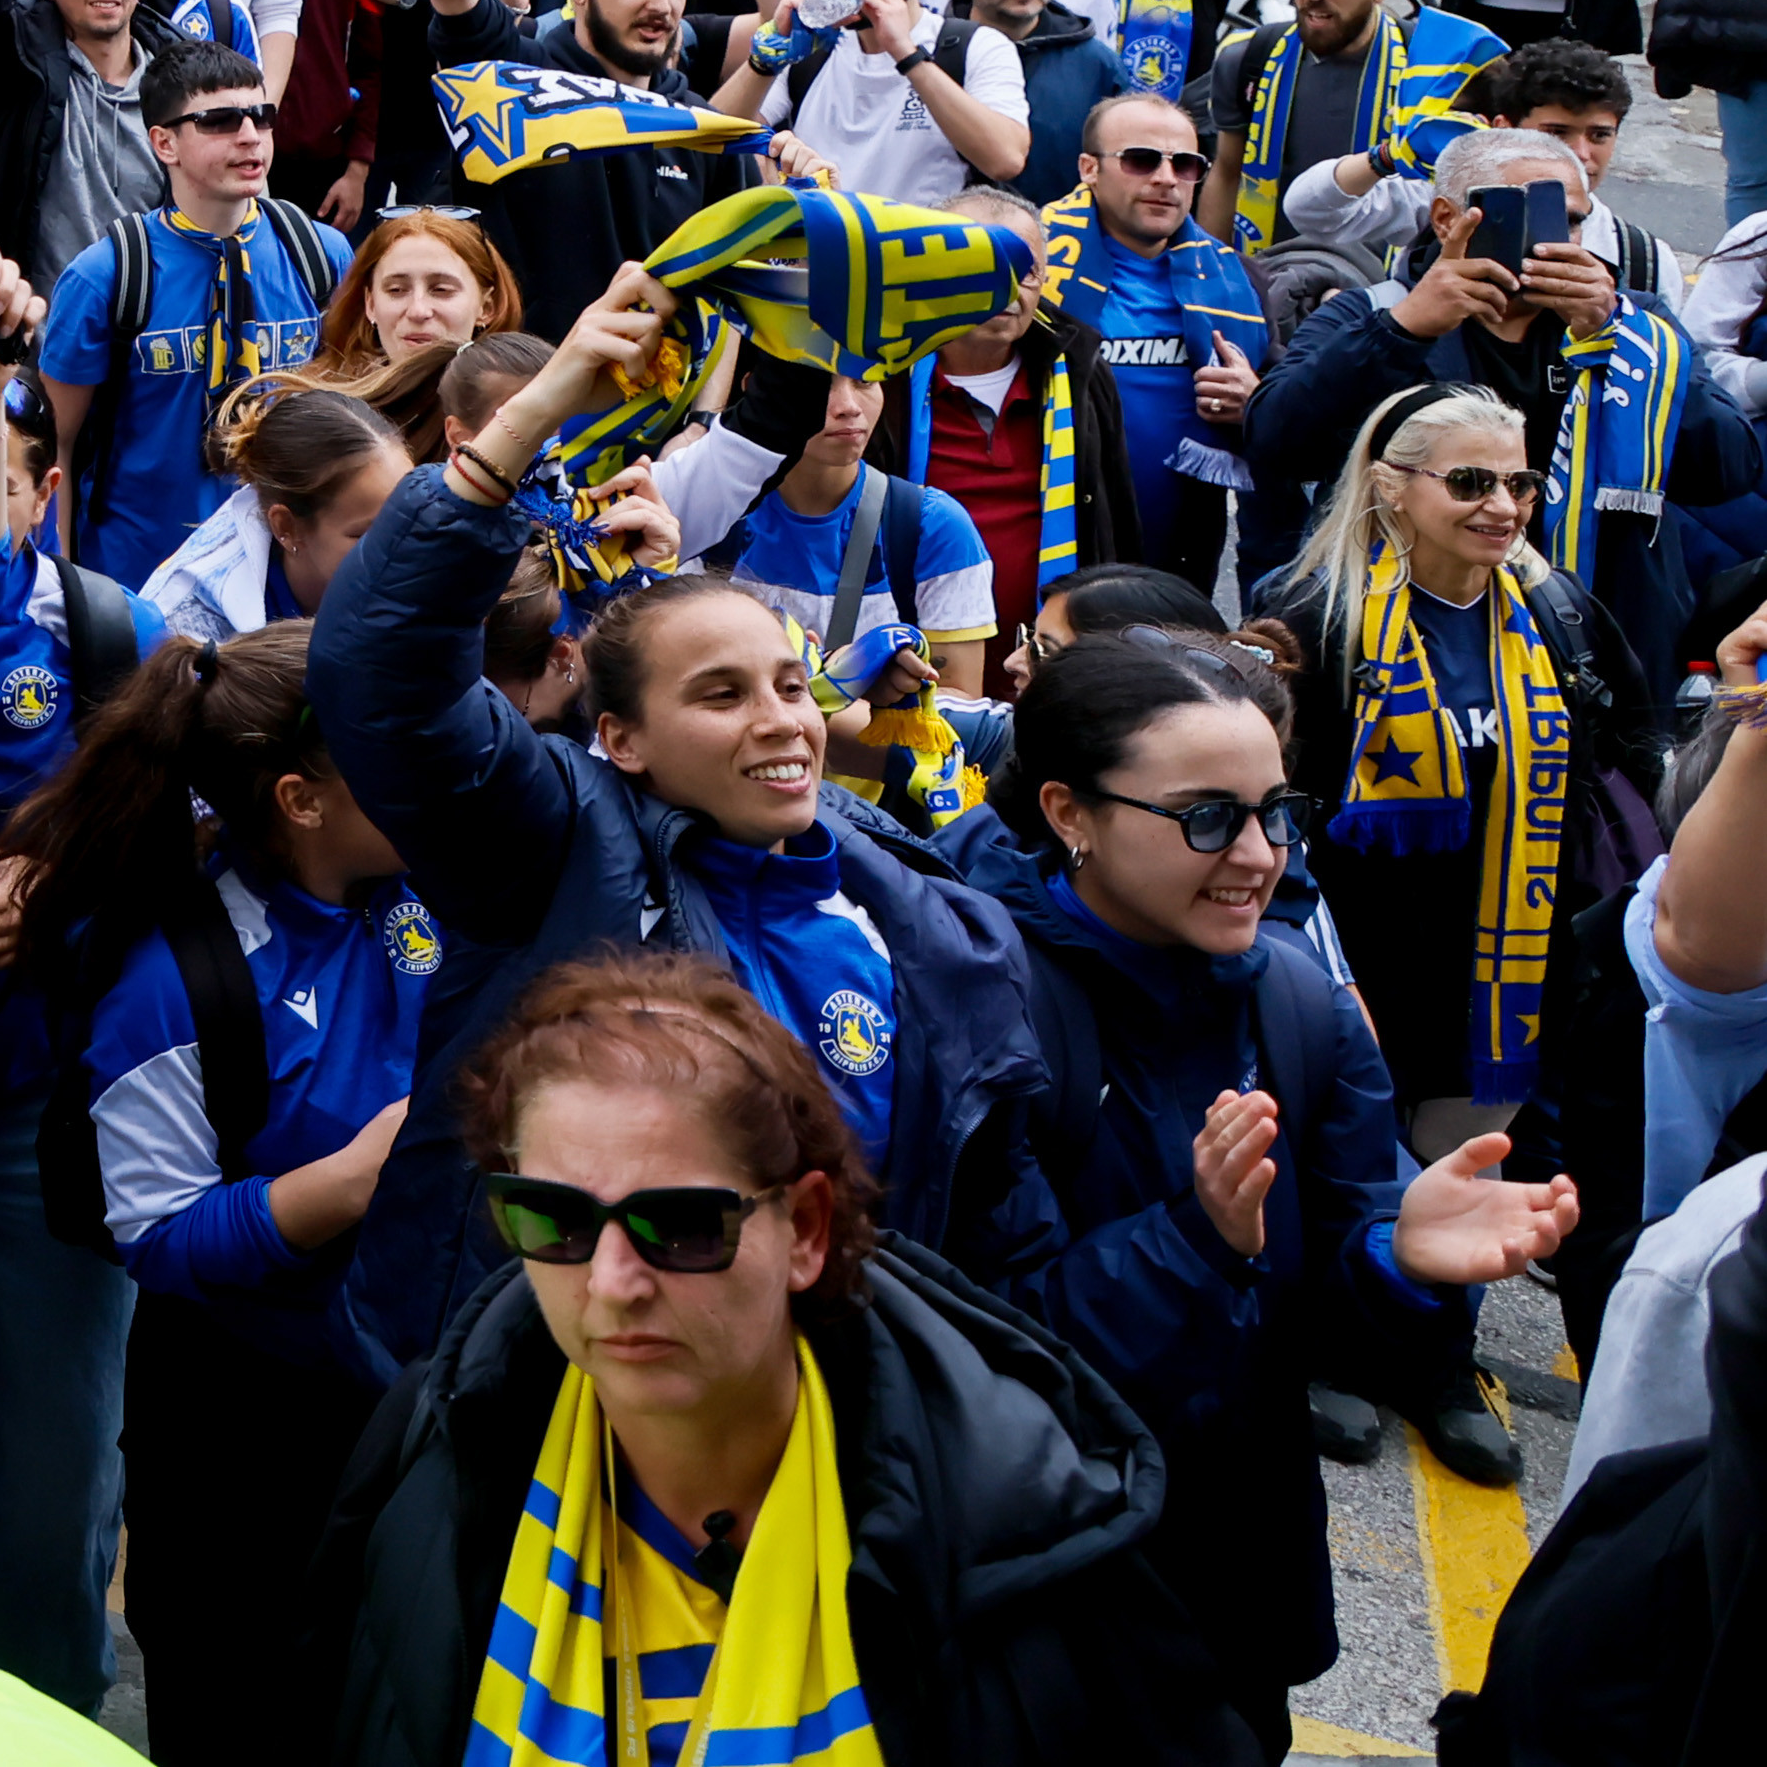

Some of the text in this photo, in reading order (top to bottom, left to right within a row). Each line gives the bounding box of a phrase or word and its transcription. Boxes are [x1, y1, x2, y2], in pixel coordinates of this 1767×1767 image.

[7, 667, 51, 686] ASTERAS
[385, 904, 424, 936] ASTERAS
[829, 993, 877, 1019] ASTERAS
[818, 1022, 891, 1043] 19 31
[828, 1048, 868, 1072] TRIPOLIS
